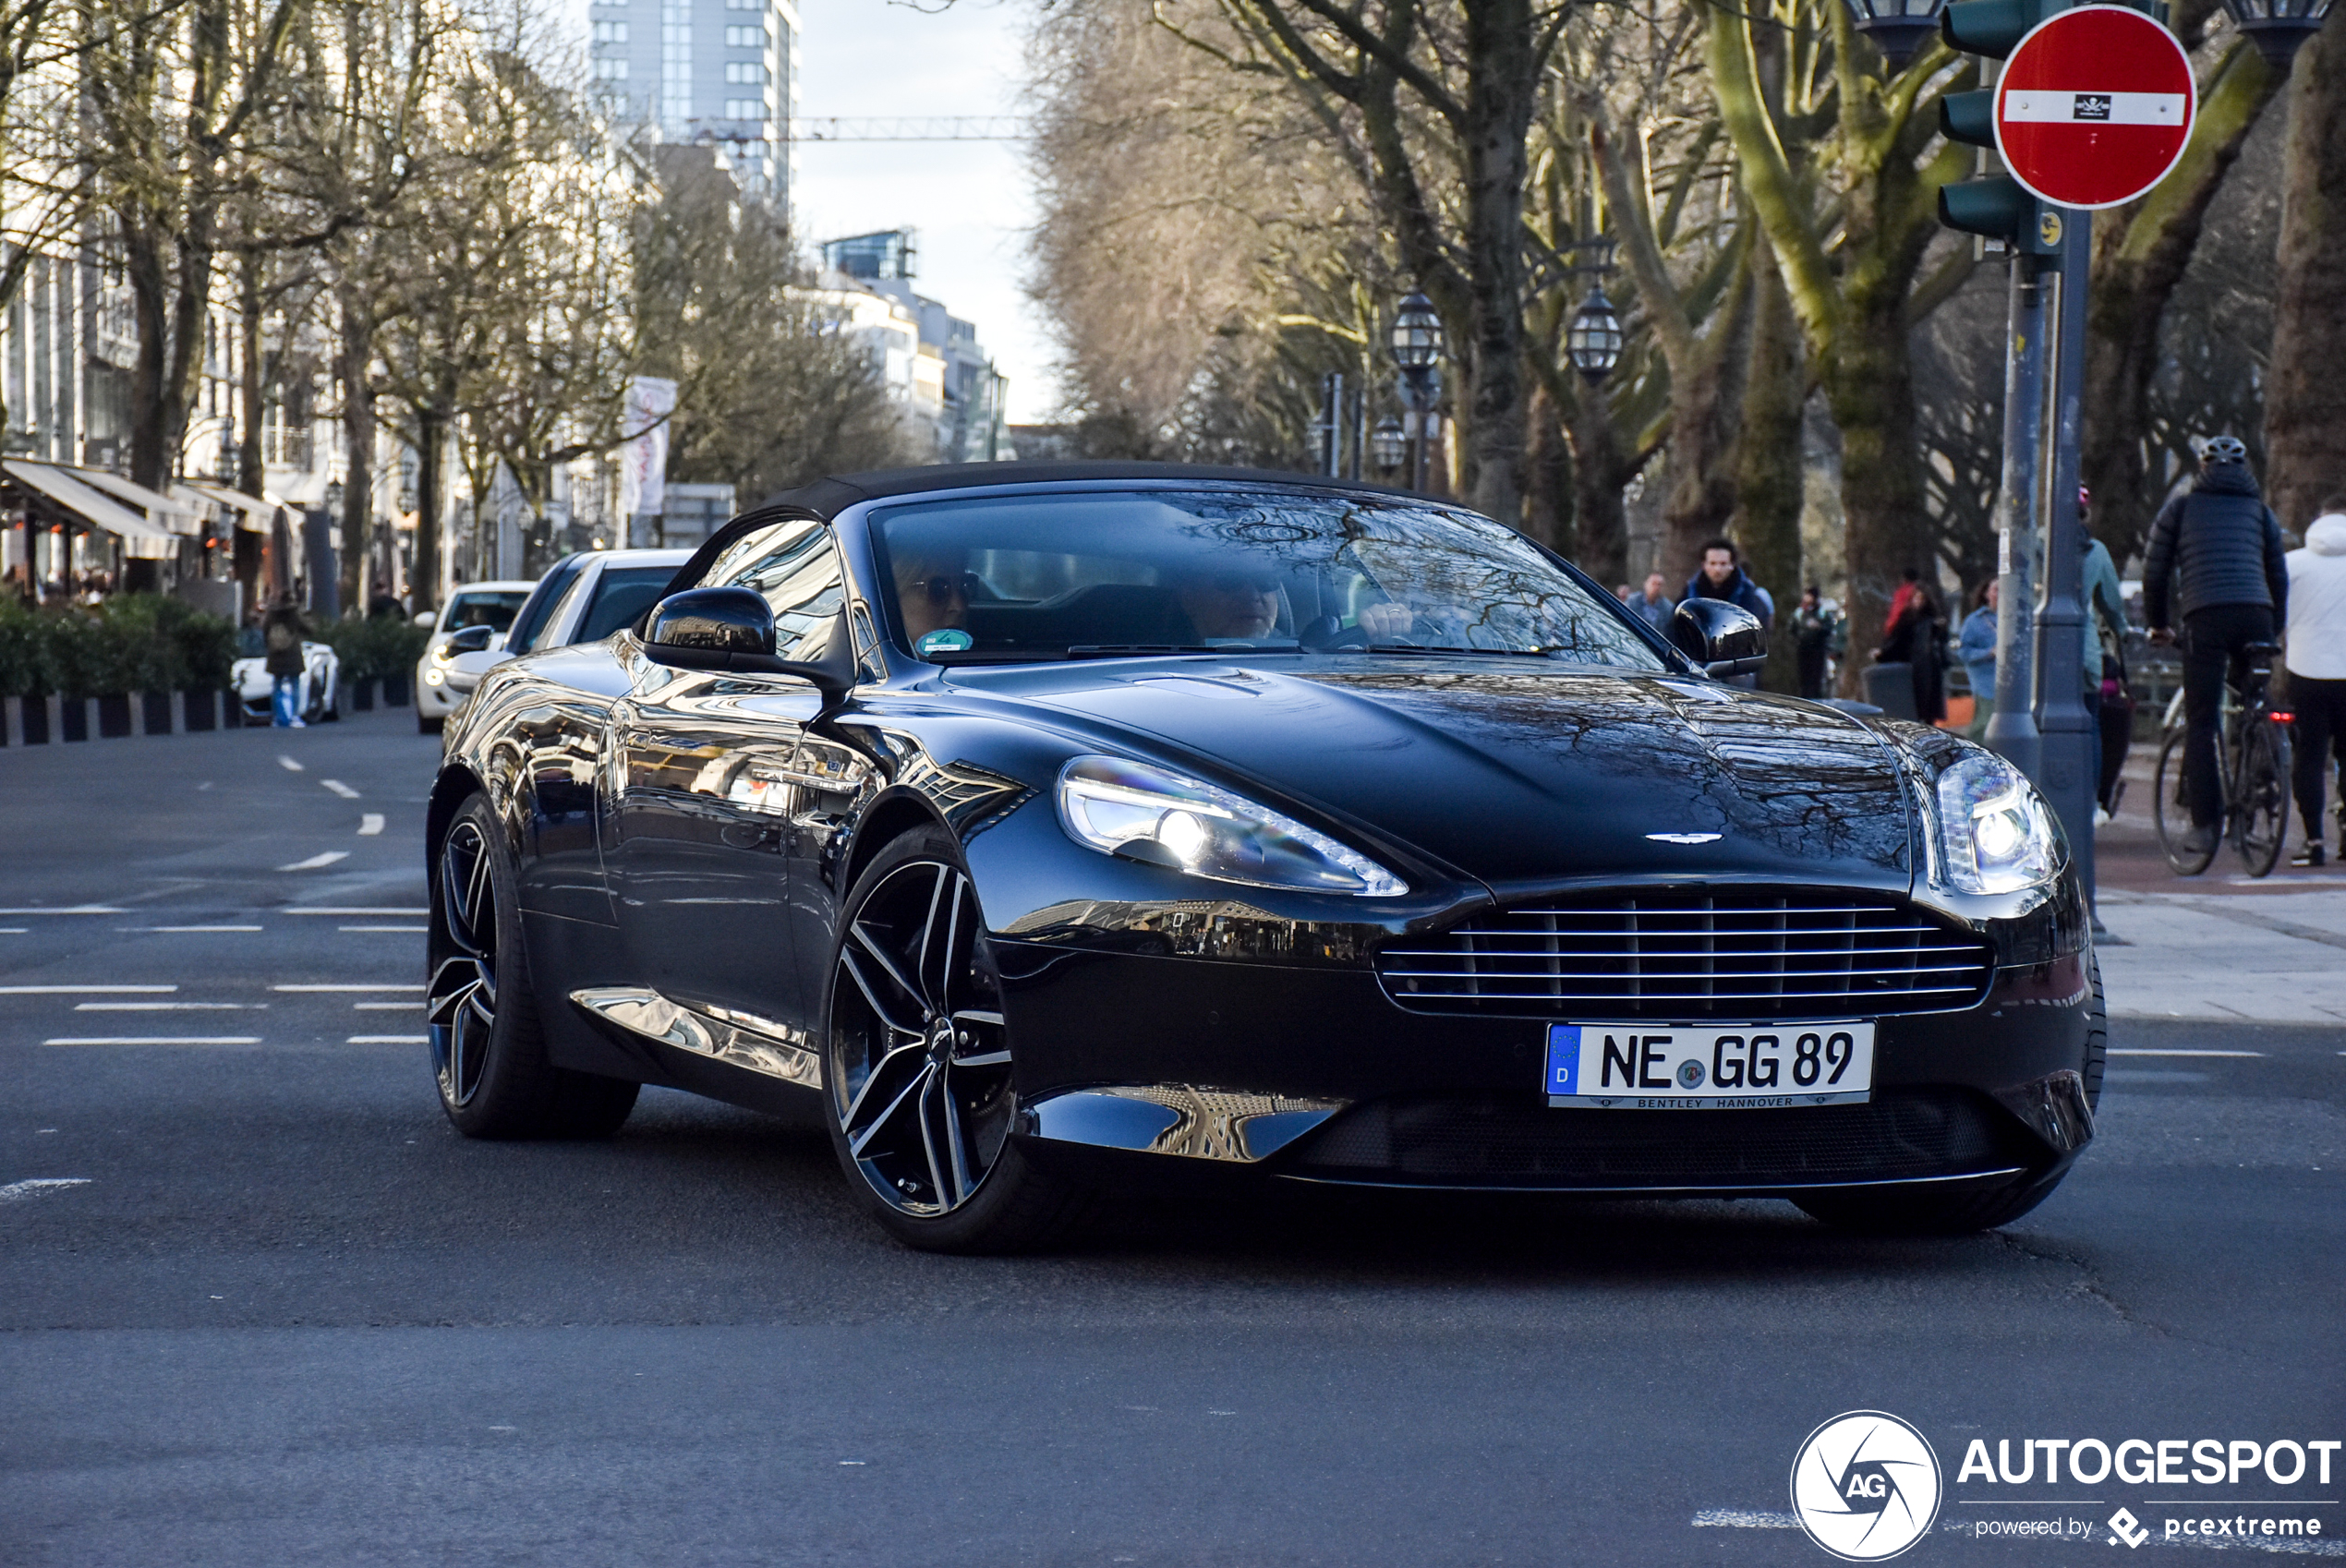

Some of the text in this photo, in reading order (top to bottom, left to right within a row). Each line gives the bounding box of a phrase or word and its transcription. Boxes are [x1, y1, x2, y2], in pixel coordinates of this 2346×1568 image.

[1601, 1034, 1674, 1088] NE
[1711, 1035, 1780, 1088] GG
[1792, 1032, 1854, 1087] 89
[1556, 1067, 1568, 1083] D
[1638, 1097, 1793, 1108] BENTLEY HANNOVER
